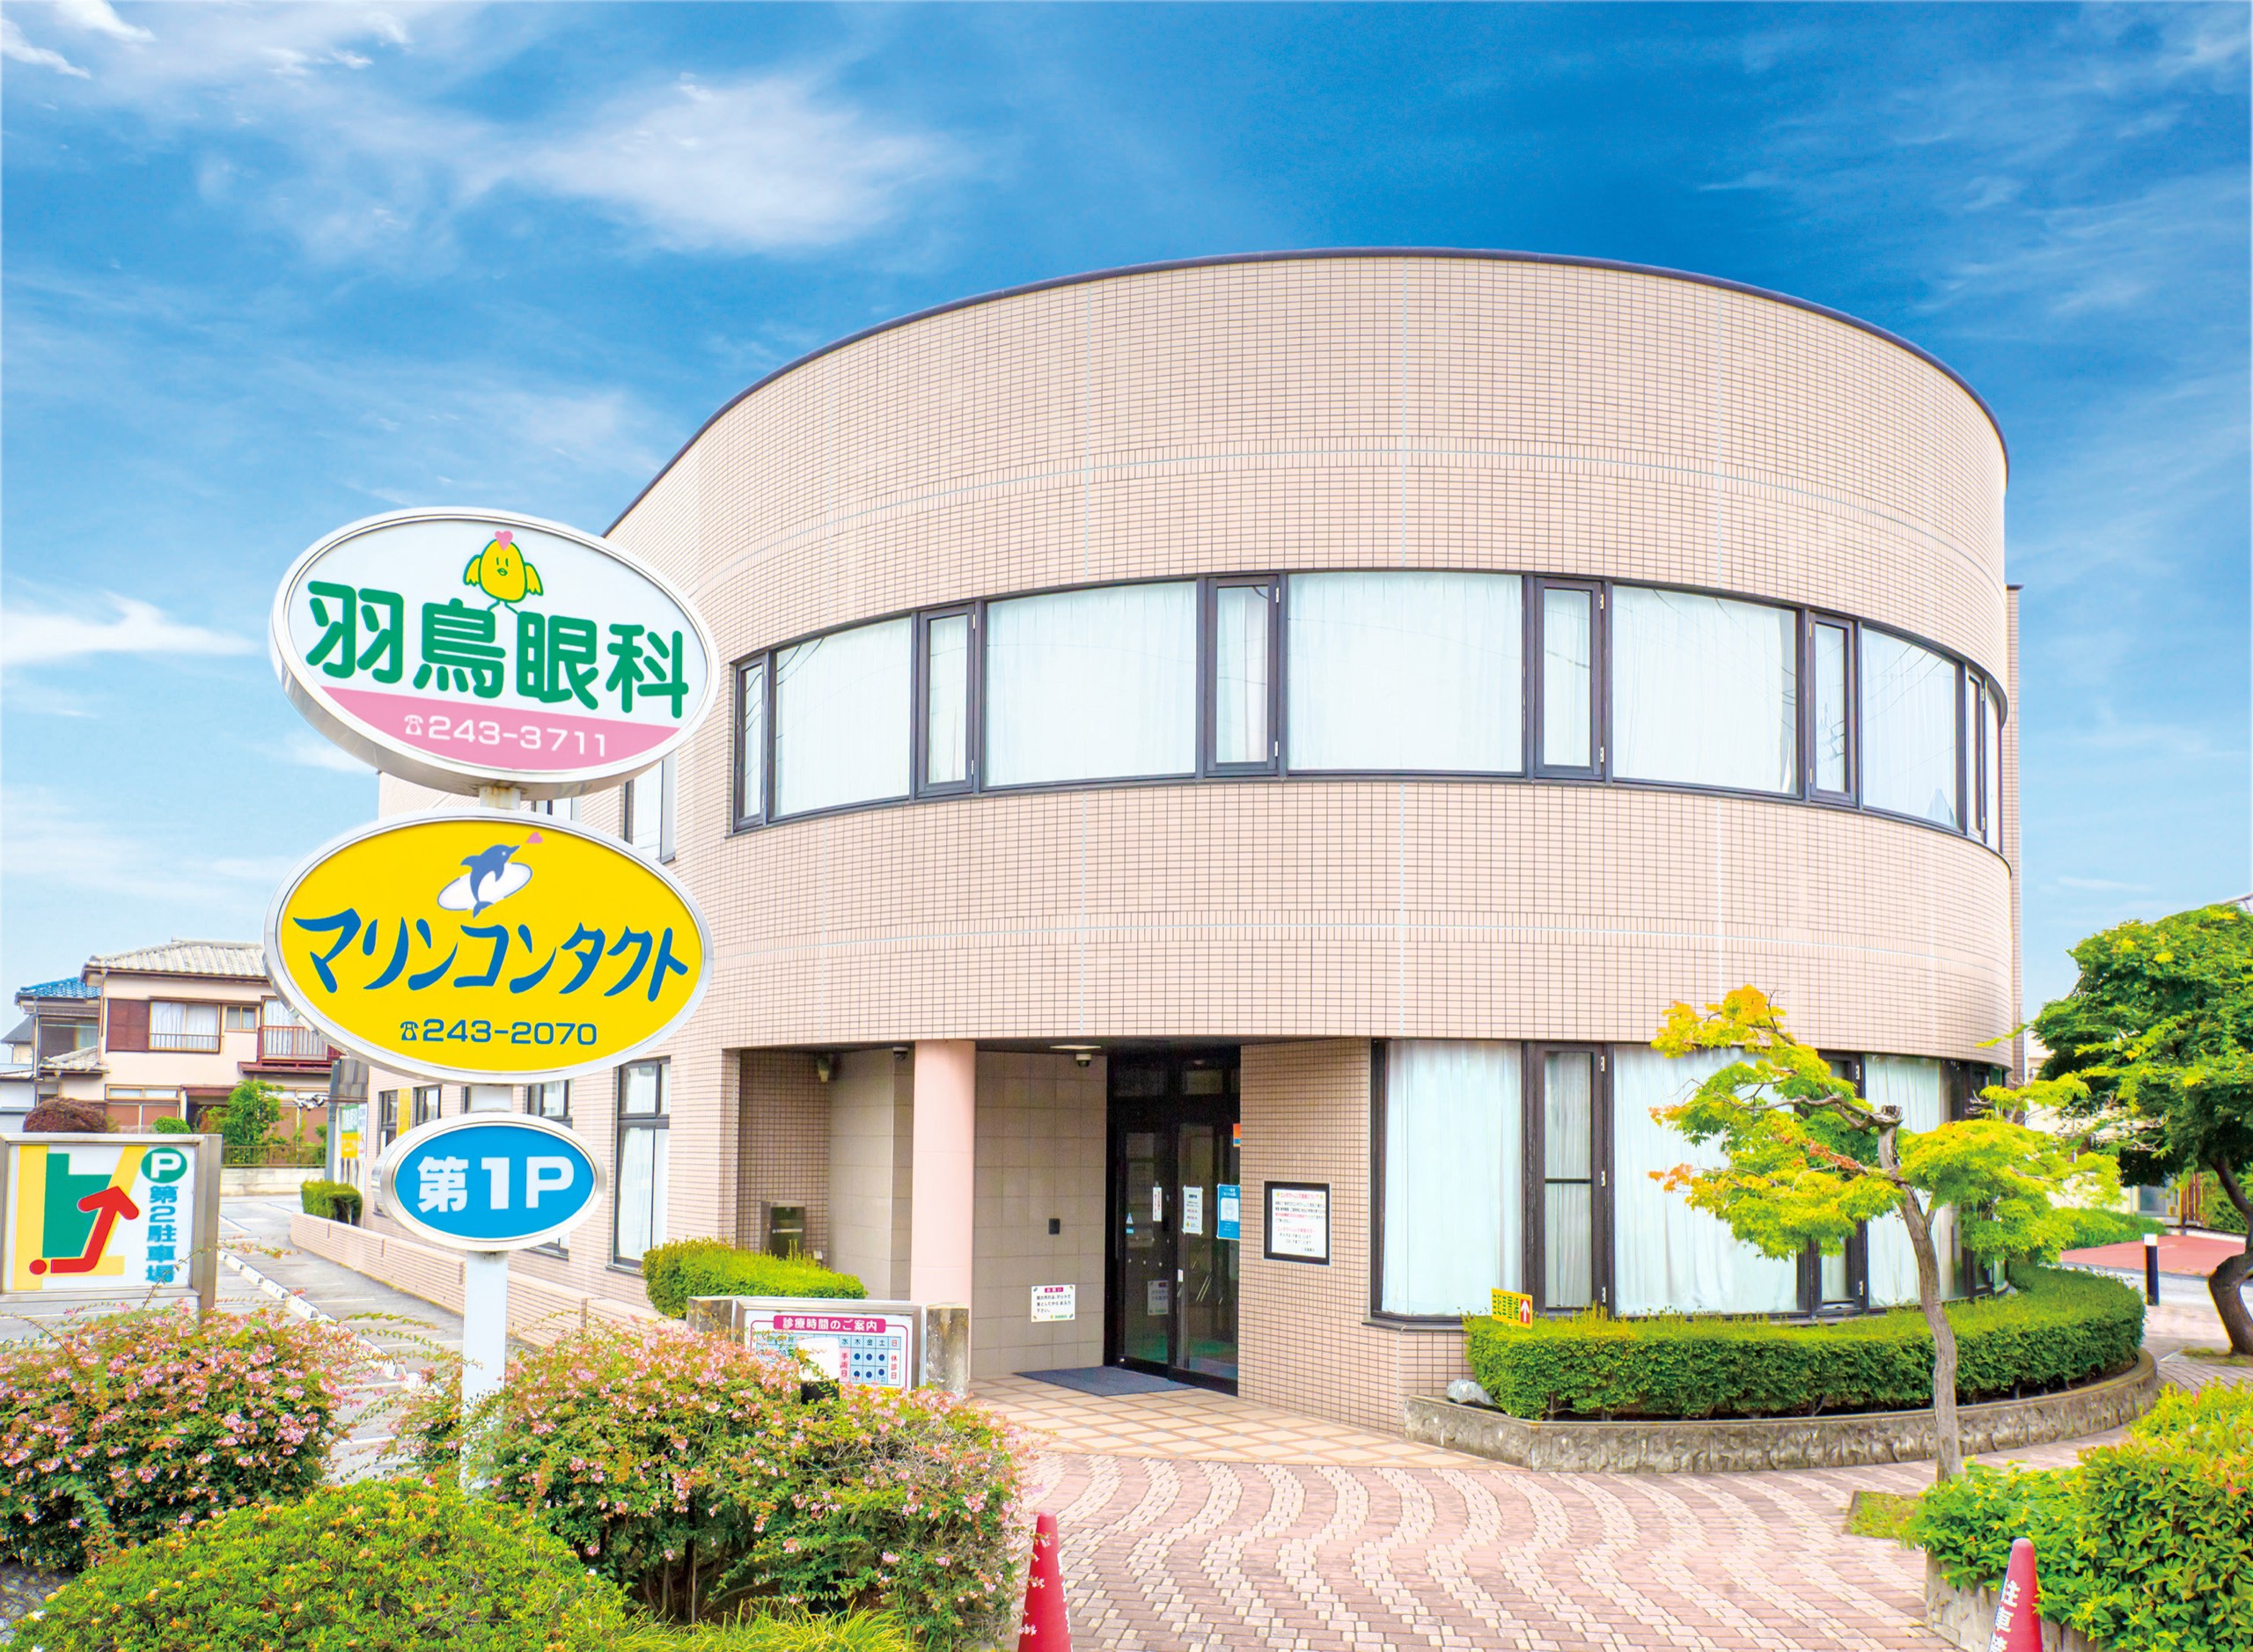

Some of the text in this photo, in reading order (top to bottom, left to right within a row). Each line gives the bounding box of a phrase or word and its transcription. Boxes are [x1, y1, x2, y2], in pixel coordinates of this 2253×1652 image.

[307, 581, 689, 719] 羽鳥眼科
[428, 715, 606, 757] 243-3711
[293, 907, 688, 1002] マリンコンタクト
[422, 1018, 598, 1046] 243-2070
[150, 1152, 181, 1178] P
[417, 1156, 575, 1214] 第1P
[145, 1185, 179, 1283] 第2駐車場
[782, 1317, 877, 1333] 診療時間のご案内
